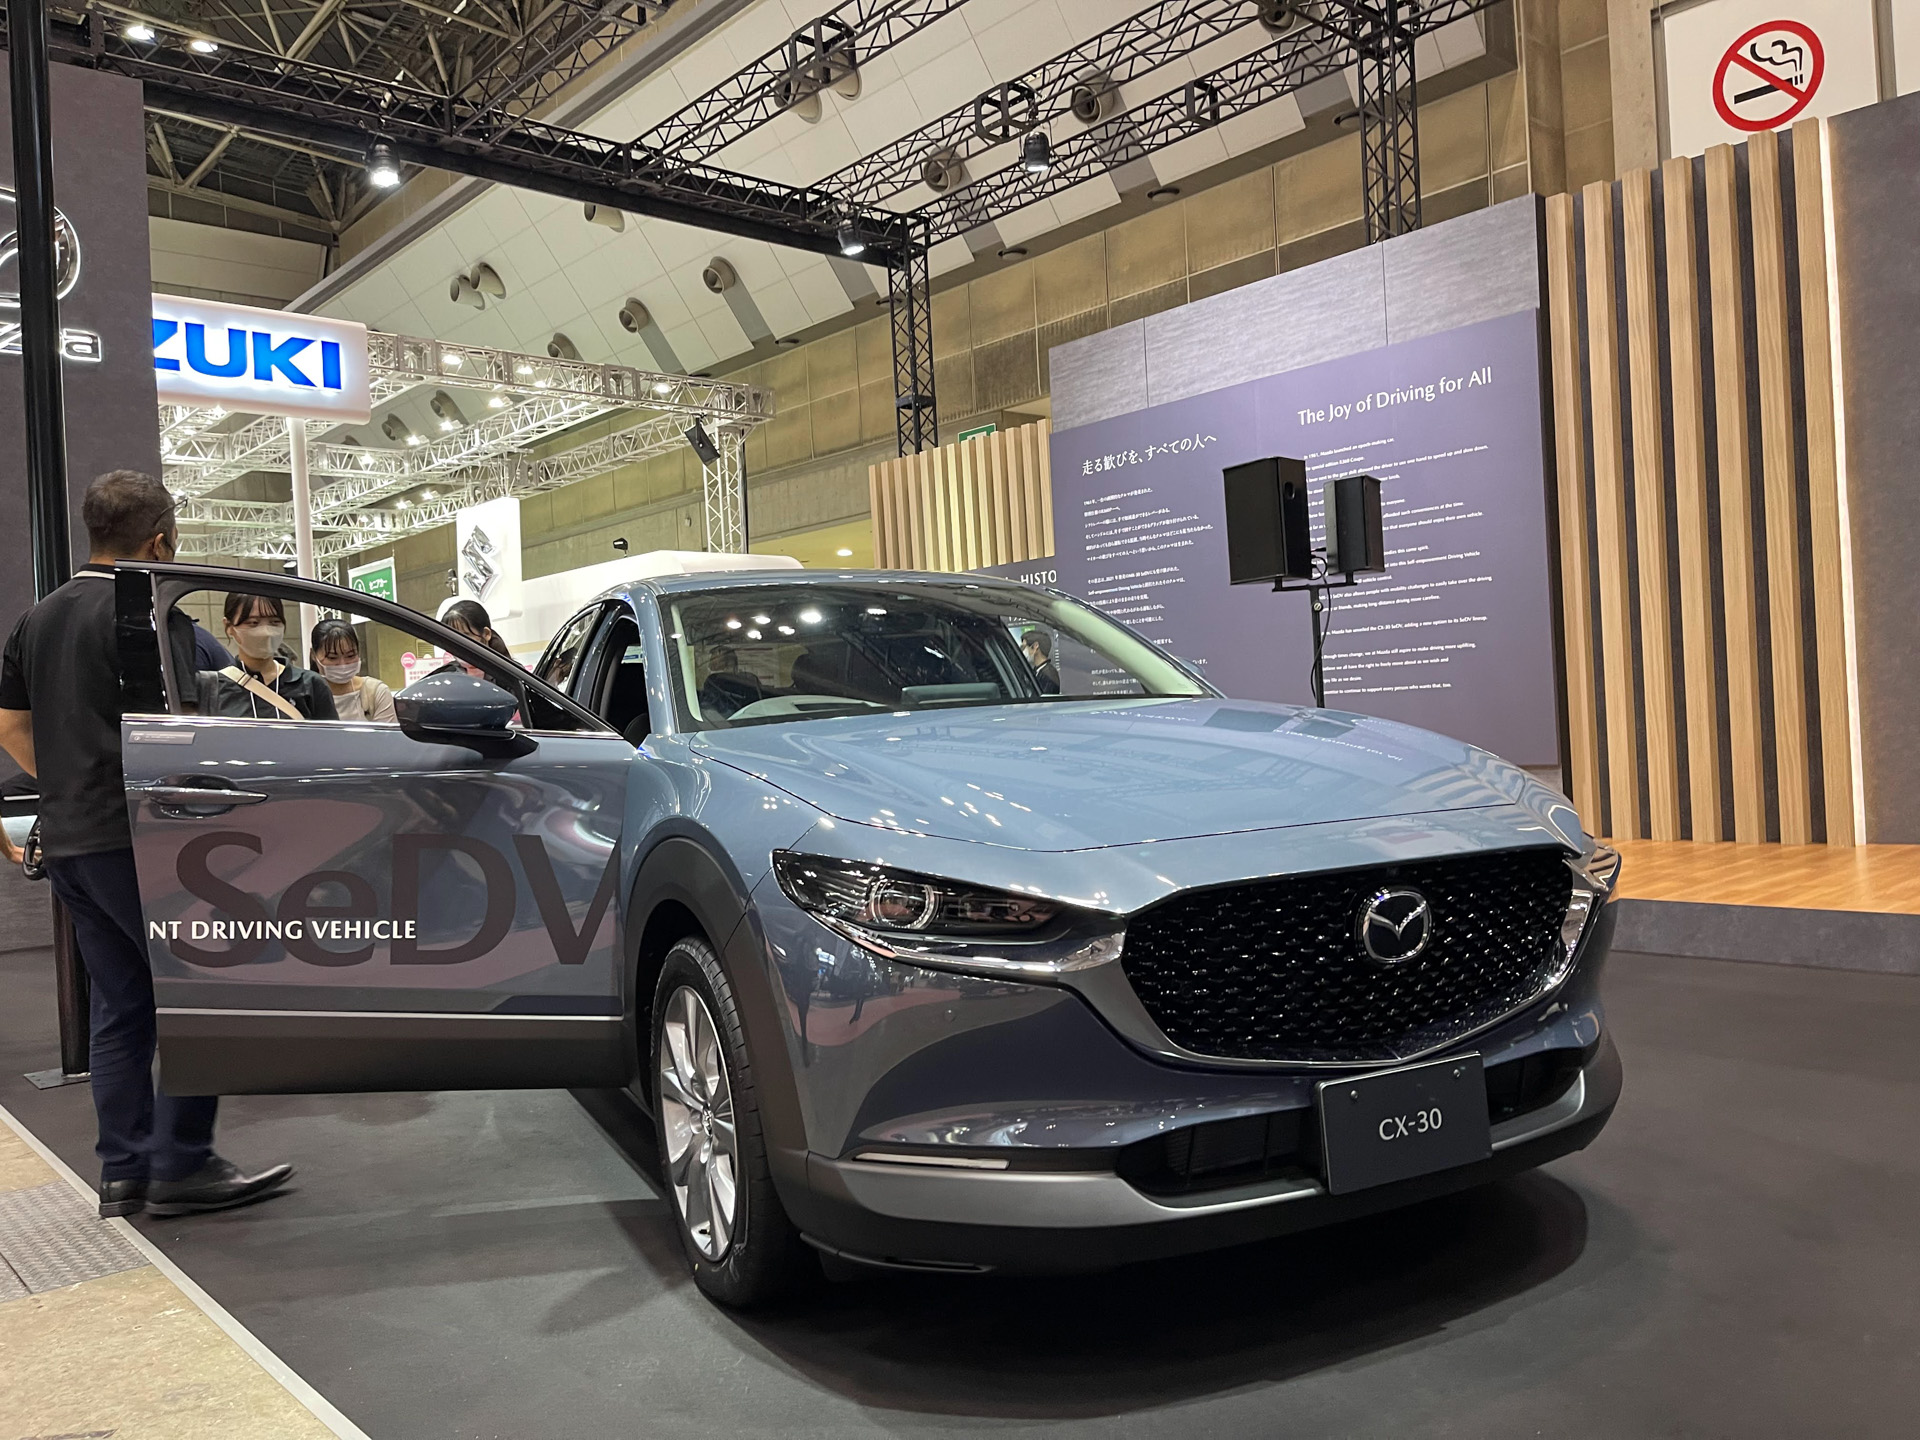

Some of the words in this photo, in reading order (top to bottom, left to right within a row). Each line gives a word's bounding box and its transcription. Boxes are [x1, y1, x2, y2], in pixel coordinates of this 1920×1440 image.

[1298, 408, 1325, 426] The
[1328, 403, 1352, 423] Joy
[1356, 394, 1372, 413] of
[1376, 385, 1436, 409] Driving
[1439, 376, 1464, 394] for
[1468, 366, 1492, 388] All
[1082, 433, 1217, 476] 走る歓びを、すべての人へ
[170, 831, 618, 967] SeDV
[149, 920, 182, 940] NT
[191, 920, 303, 940] DRIVING
[312, 920, 417, 940] VEHICLE
[1378, 1107, 1443, 1141] CX-30
